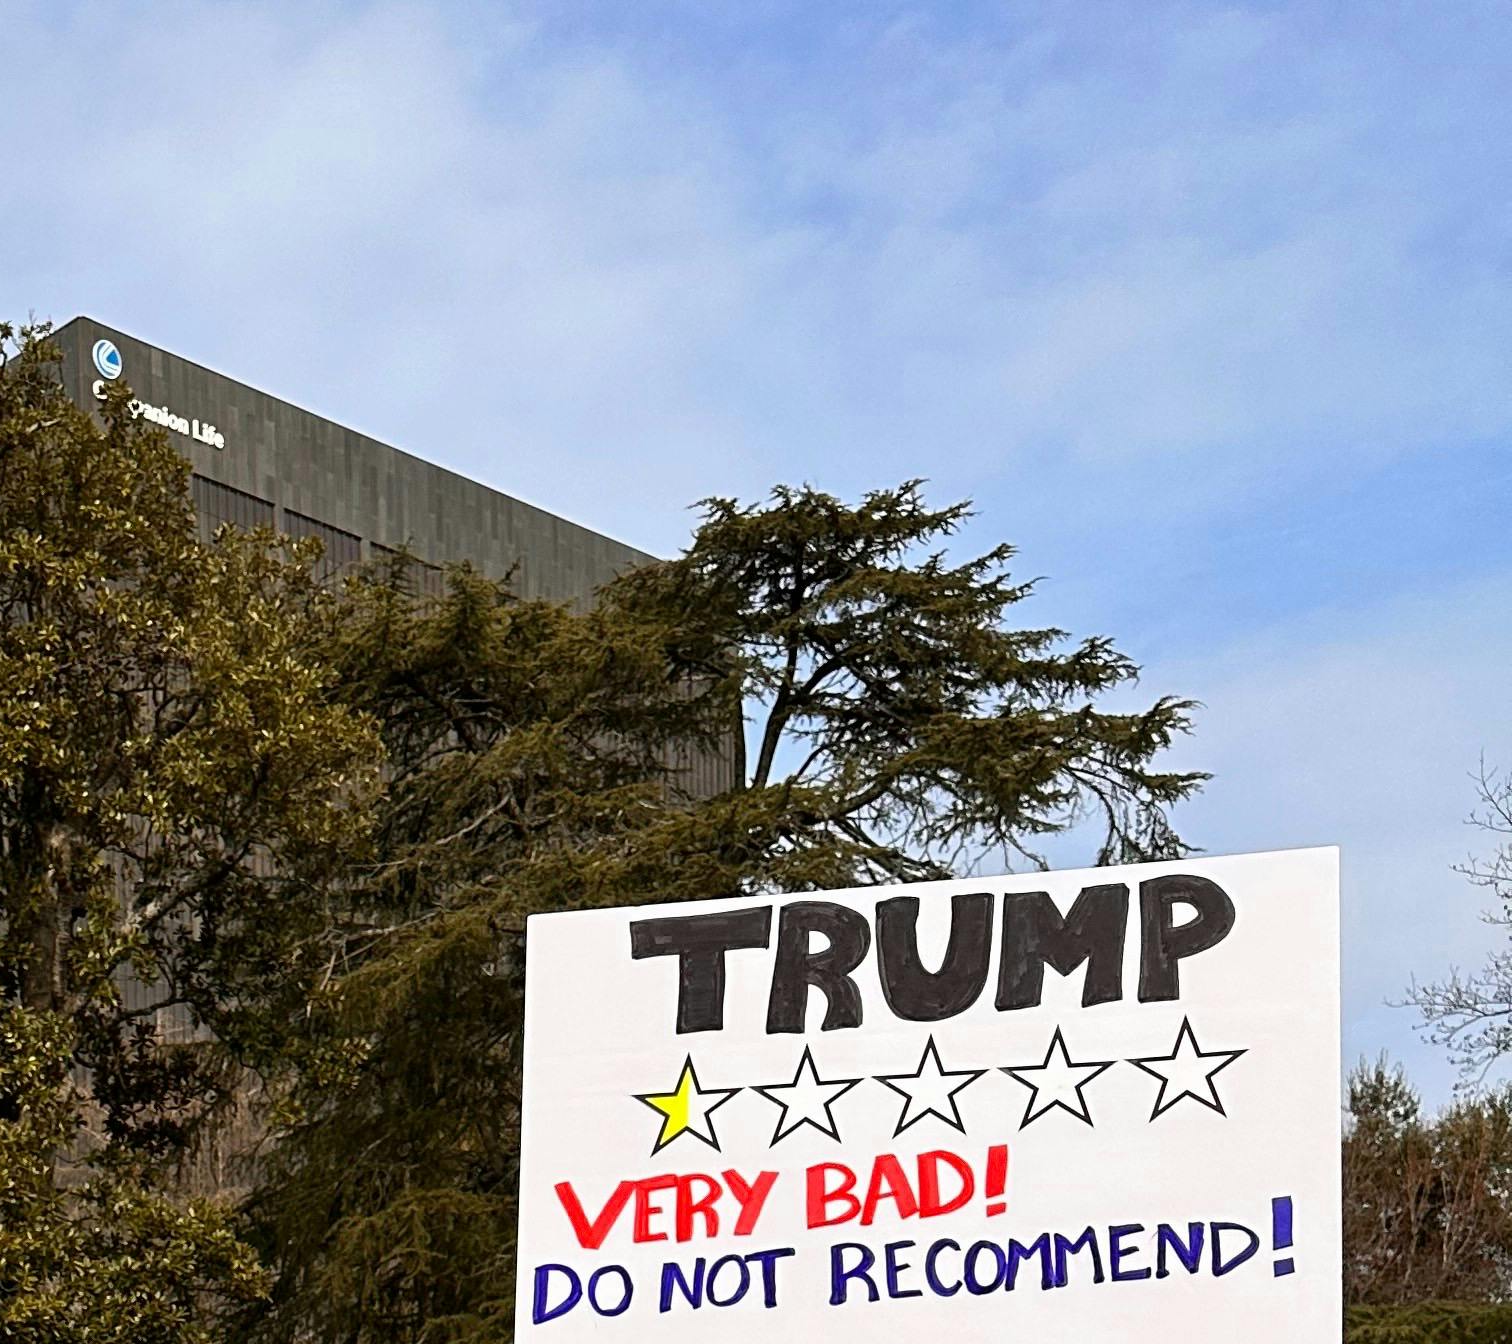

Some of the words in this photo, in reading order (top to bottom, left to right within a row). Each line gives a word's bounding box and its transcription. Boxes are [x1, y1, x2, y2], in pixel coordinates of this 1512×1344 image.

[92, 380, 189, 435] Cpanion
[192, 419, 225, 449] Life
[630, 875, 1235, 1034] TRUMP
[555, 1169, 779, 1249] VERY
[806, 1145, 1008, 1229] BAD!
[533, 1264, 633, 1325] DO
[660, 1248, 795, 1313] NOT
[829, 1196, 1293, 1307] RECOMMEND!
